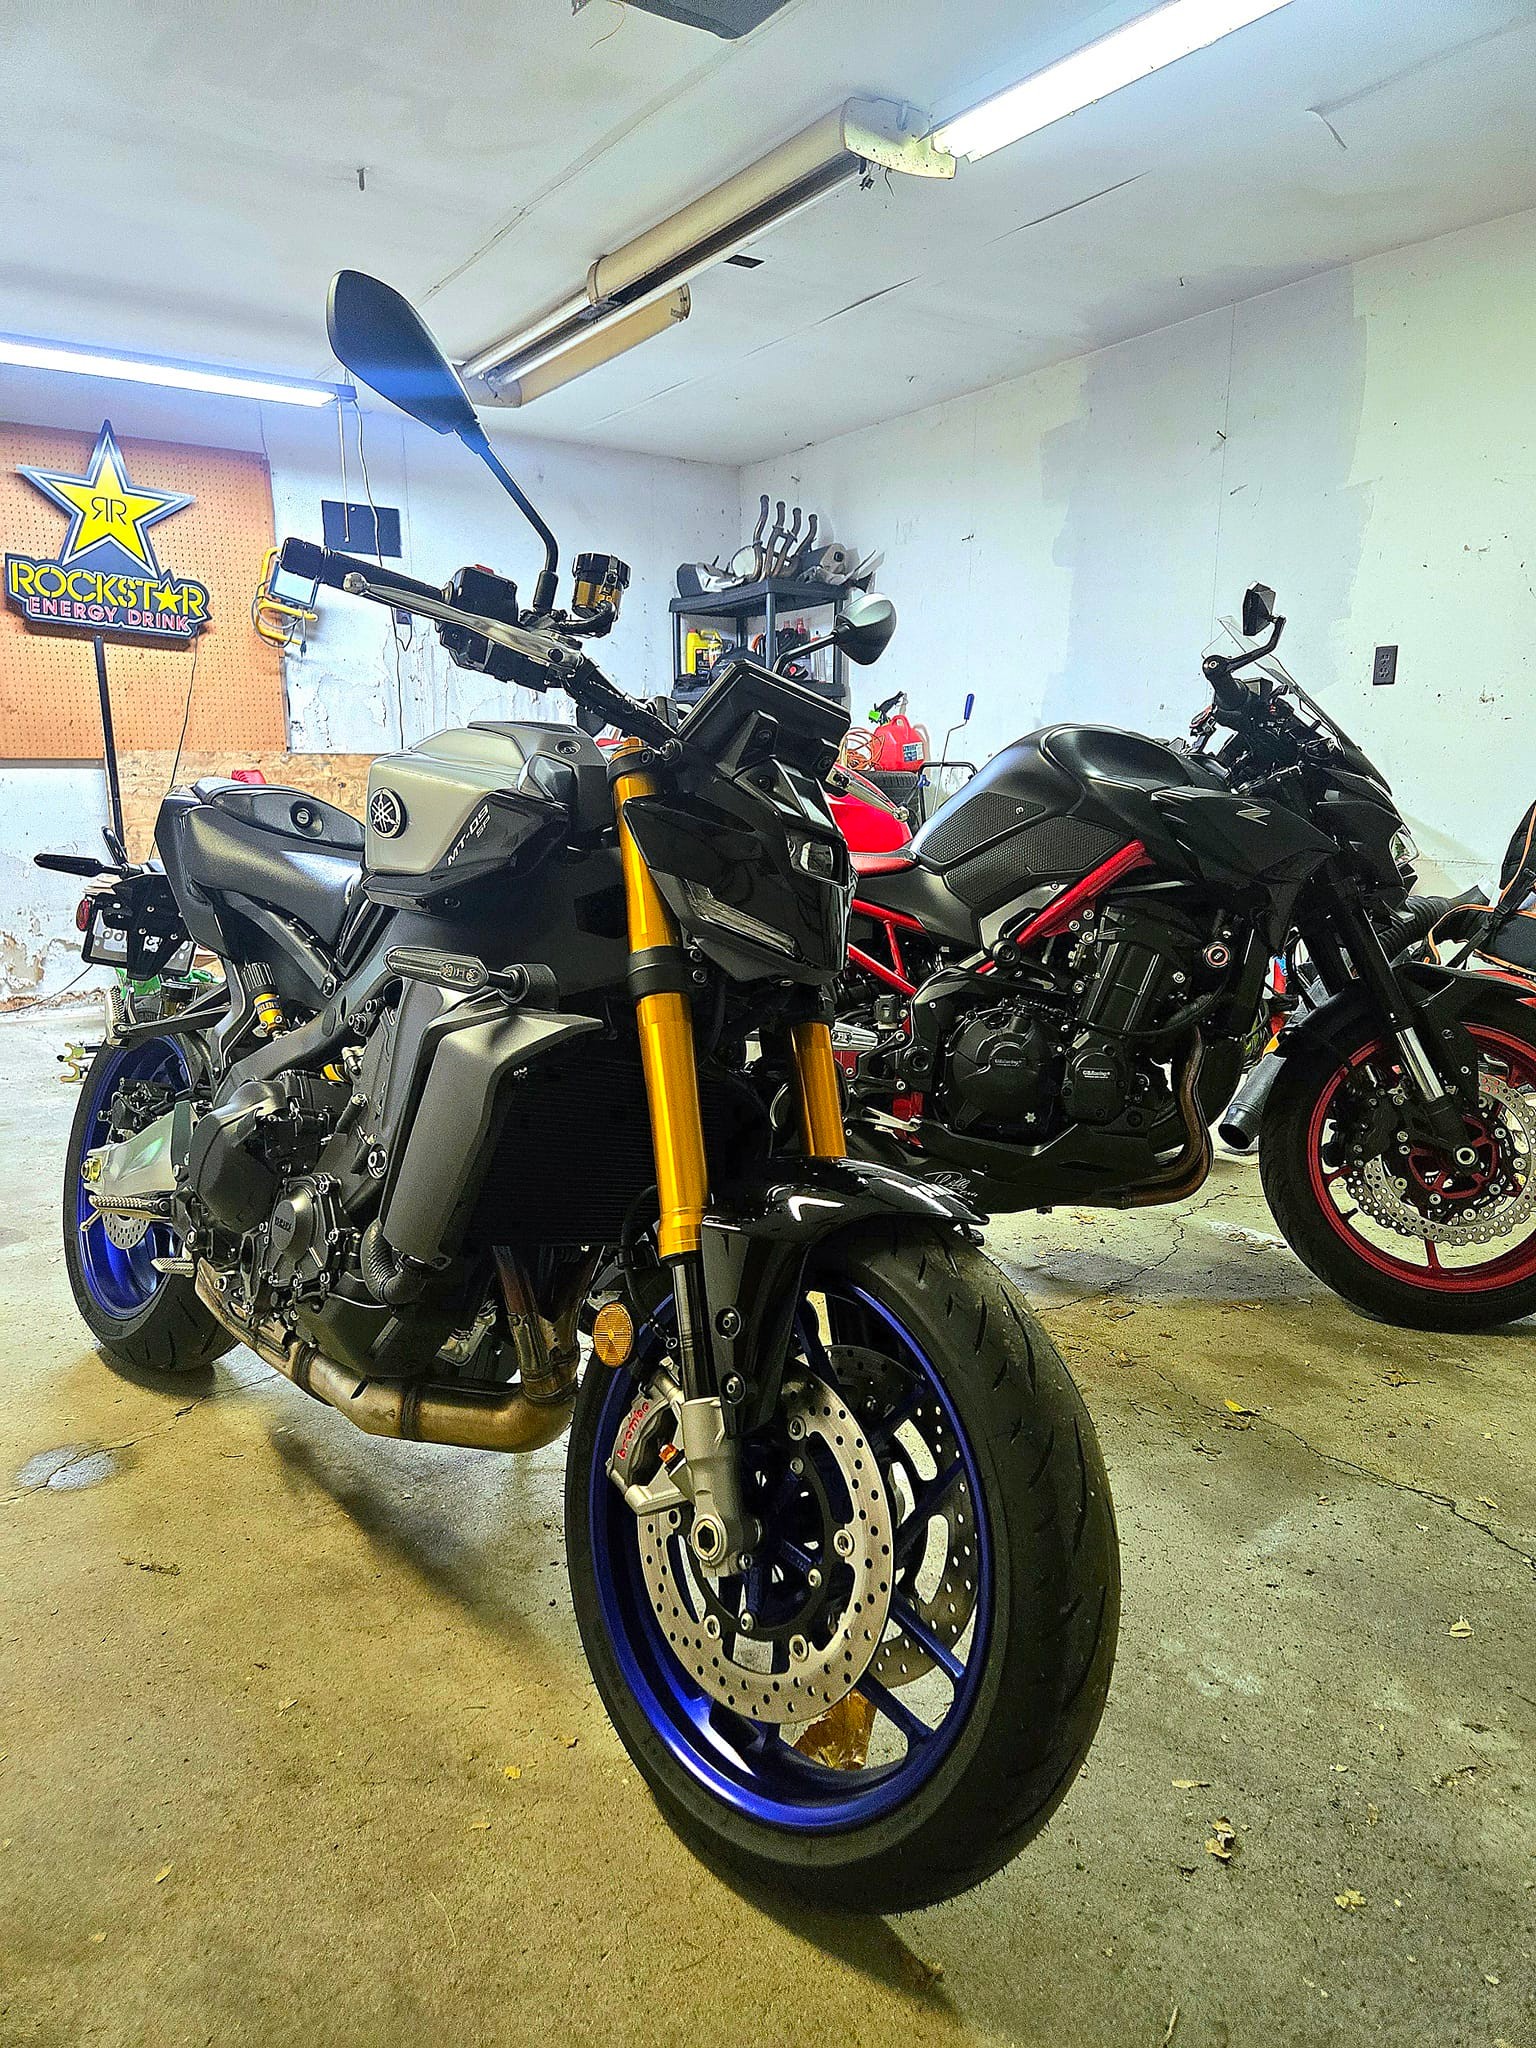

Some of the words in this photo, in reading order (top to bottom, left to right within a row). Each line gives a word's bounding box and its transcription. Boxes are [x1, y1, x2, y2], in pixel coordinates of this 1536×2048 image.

[28, 597, 118, 622] ENERGY
[128, 610, 190, 632] DRINK
[447, 804, 489, 866] MT-09
[616, 1402, 649, 1460] brembo
